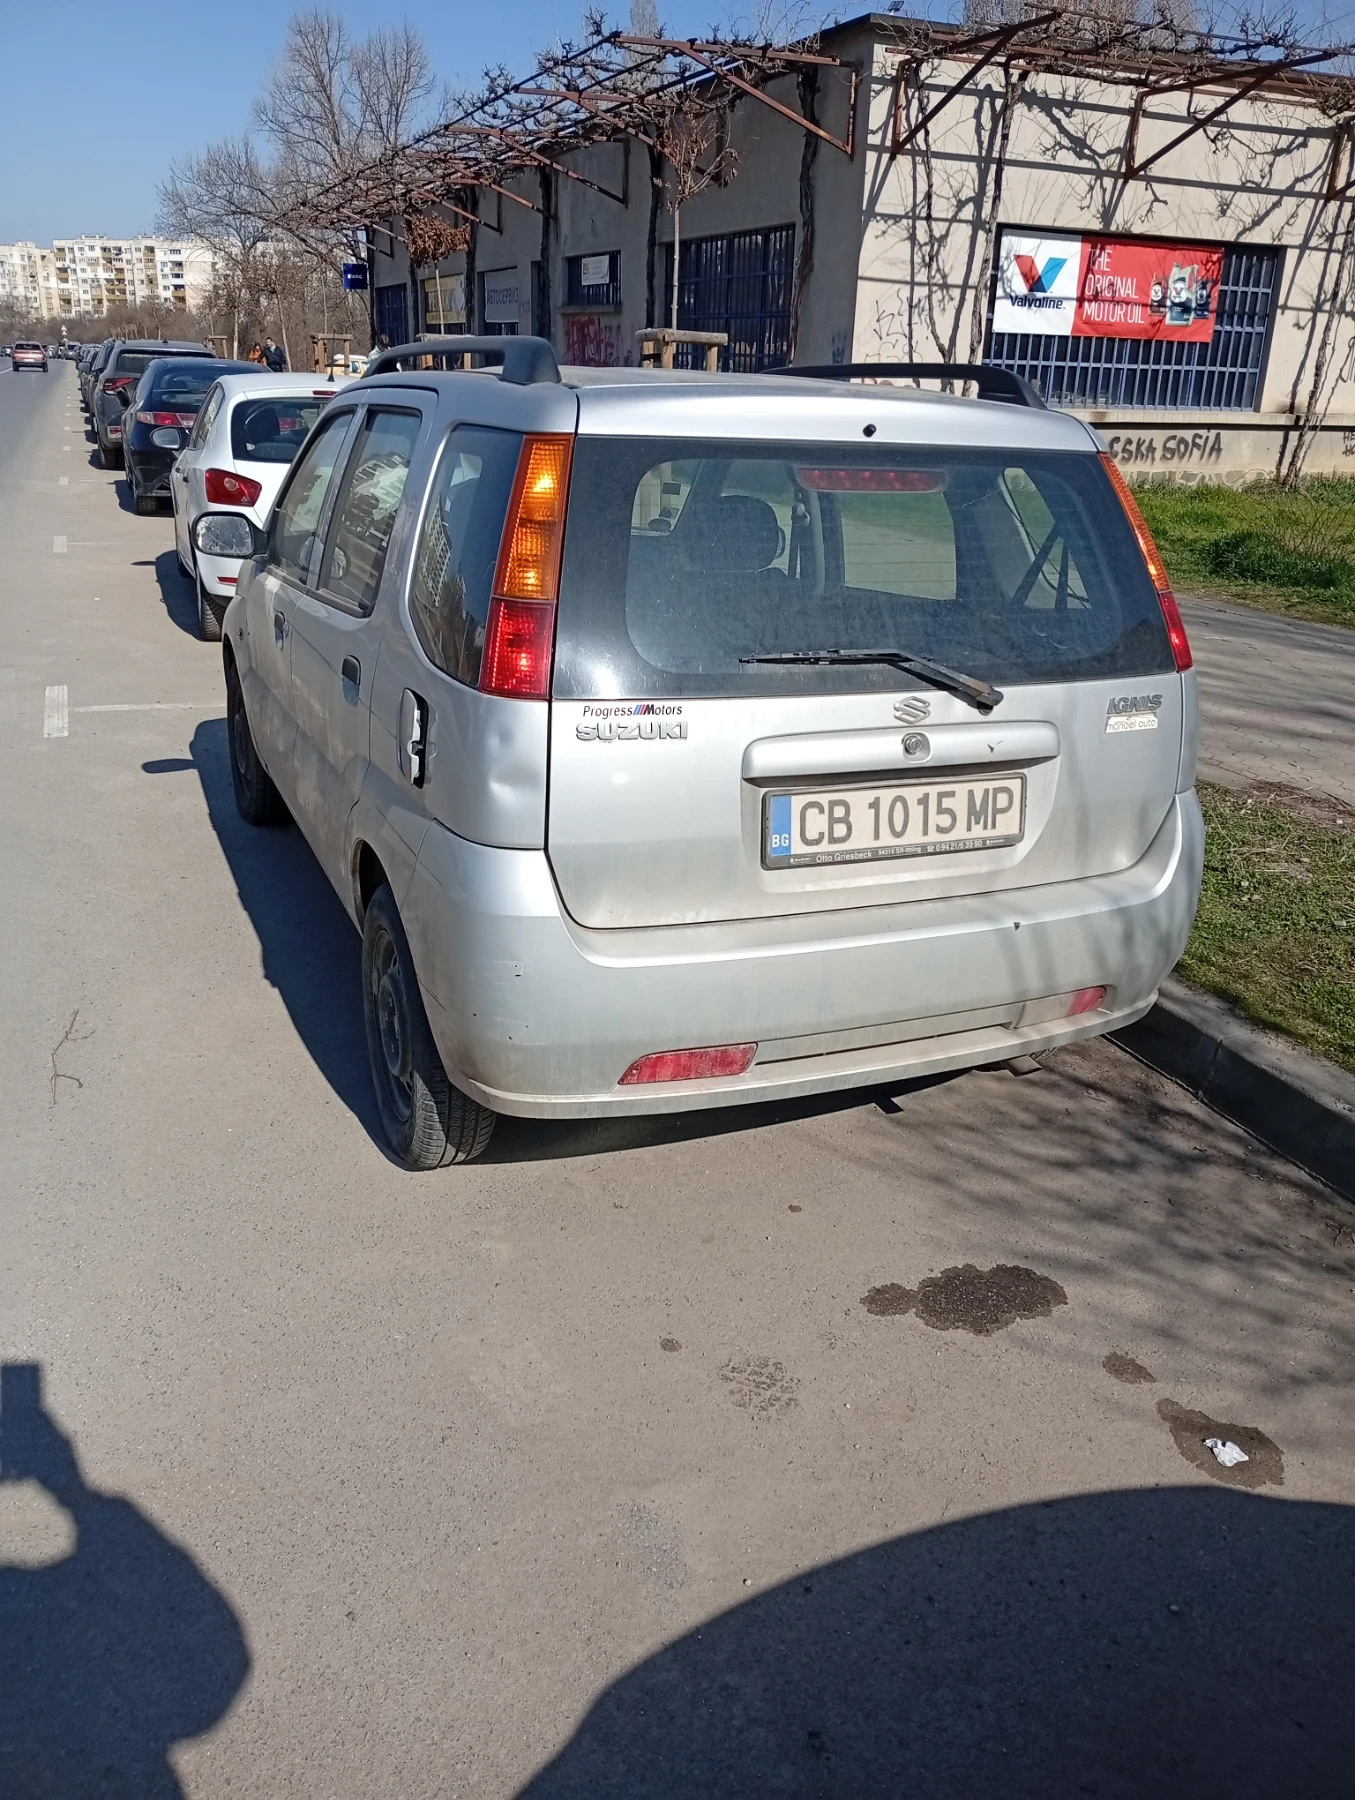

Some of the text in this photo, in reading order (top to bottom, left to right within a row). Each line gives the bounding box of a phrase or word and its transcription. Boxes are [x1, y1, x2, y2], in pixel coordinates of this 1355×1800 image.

[1088, 248, 1113, 271] THE
[1085, 273, 1139, 298] ORIGINAL
[1009, 294, 1063, 310] Valvoline
[1082, 300, 1145, 324] MOTOR OIL
[1109, 436, 1157, 465] CSKA
[582, 704, 683, 720] Progress Motors
[1106, 694, 1163, 714] IGNIS
[576, 721, 689, 741] SUZUKI
[1138, 719, 1156, 728] auto
[799, 785, 1015, 847] CB 1015 MP
[772, 834, 790, 848] BG
[816, 855, 833, 863] Otto
[834, 850, 873, 861] Griesbeck
